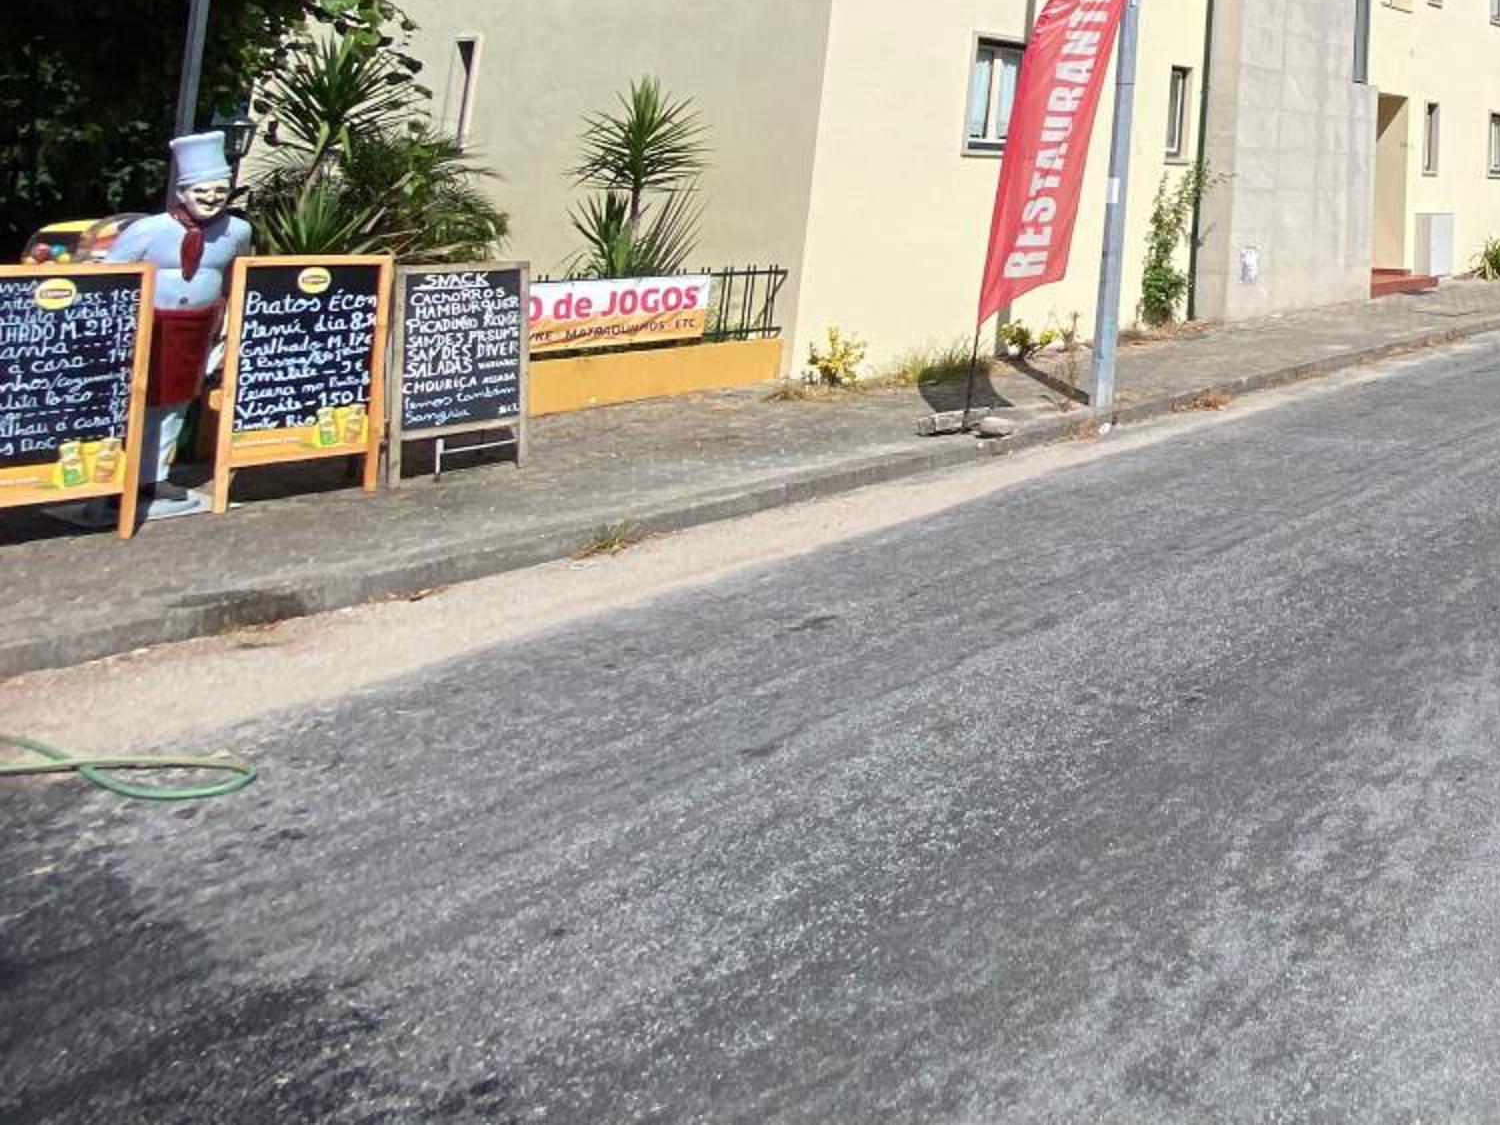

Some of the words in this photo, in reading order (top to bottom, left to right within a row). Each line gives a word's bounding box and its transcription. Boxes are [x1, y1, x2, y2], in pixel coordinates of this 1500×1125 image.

[420, 272, 490, 290] SNACK
[552, 292, 593, 321] de
[601, 284, 699, 318] JOGOS
